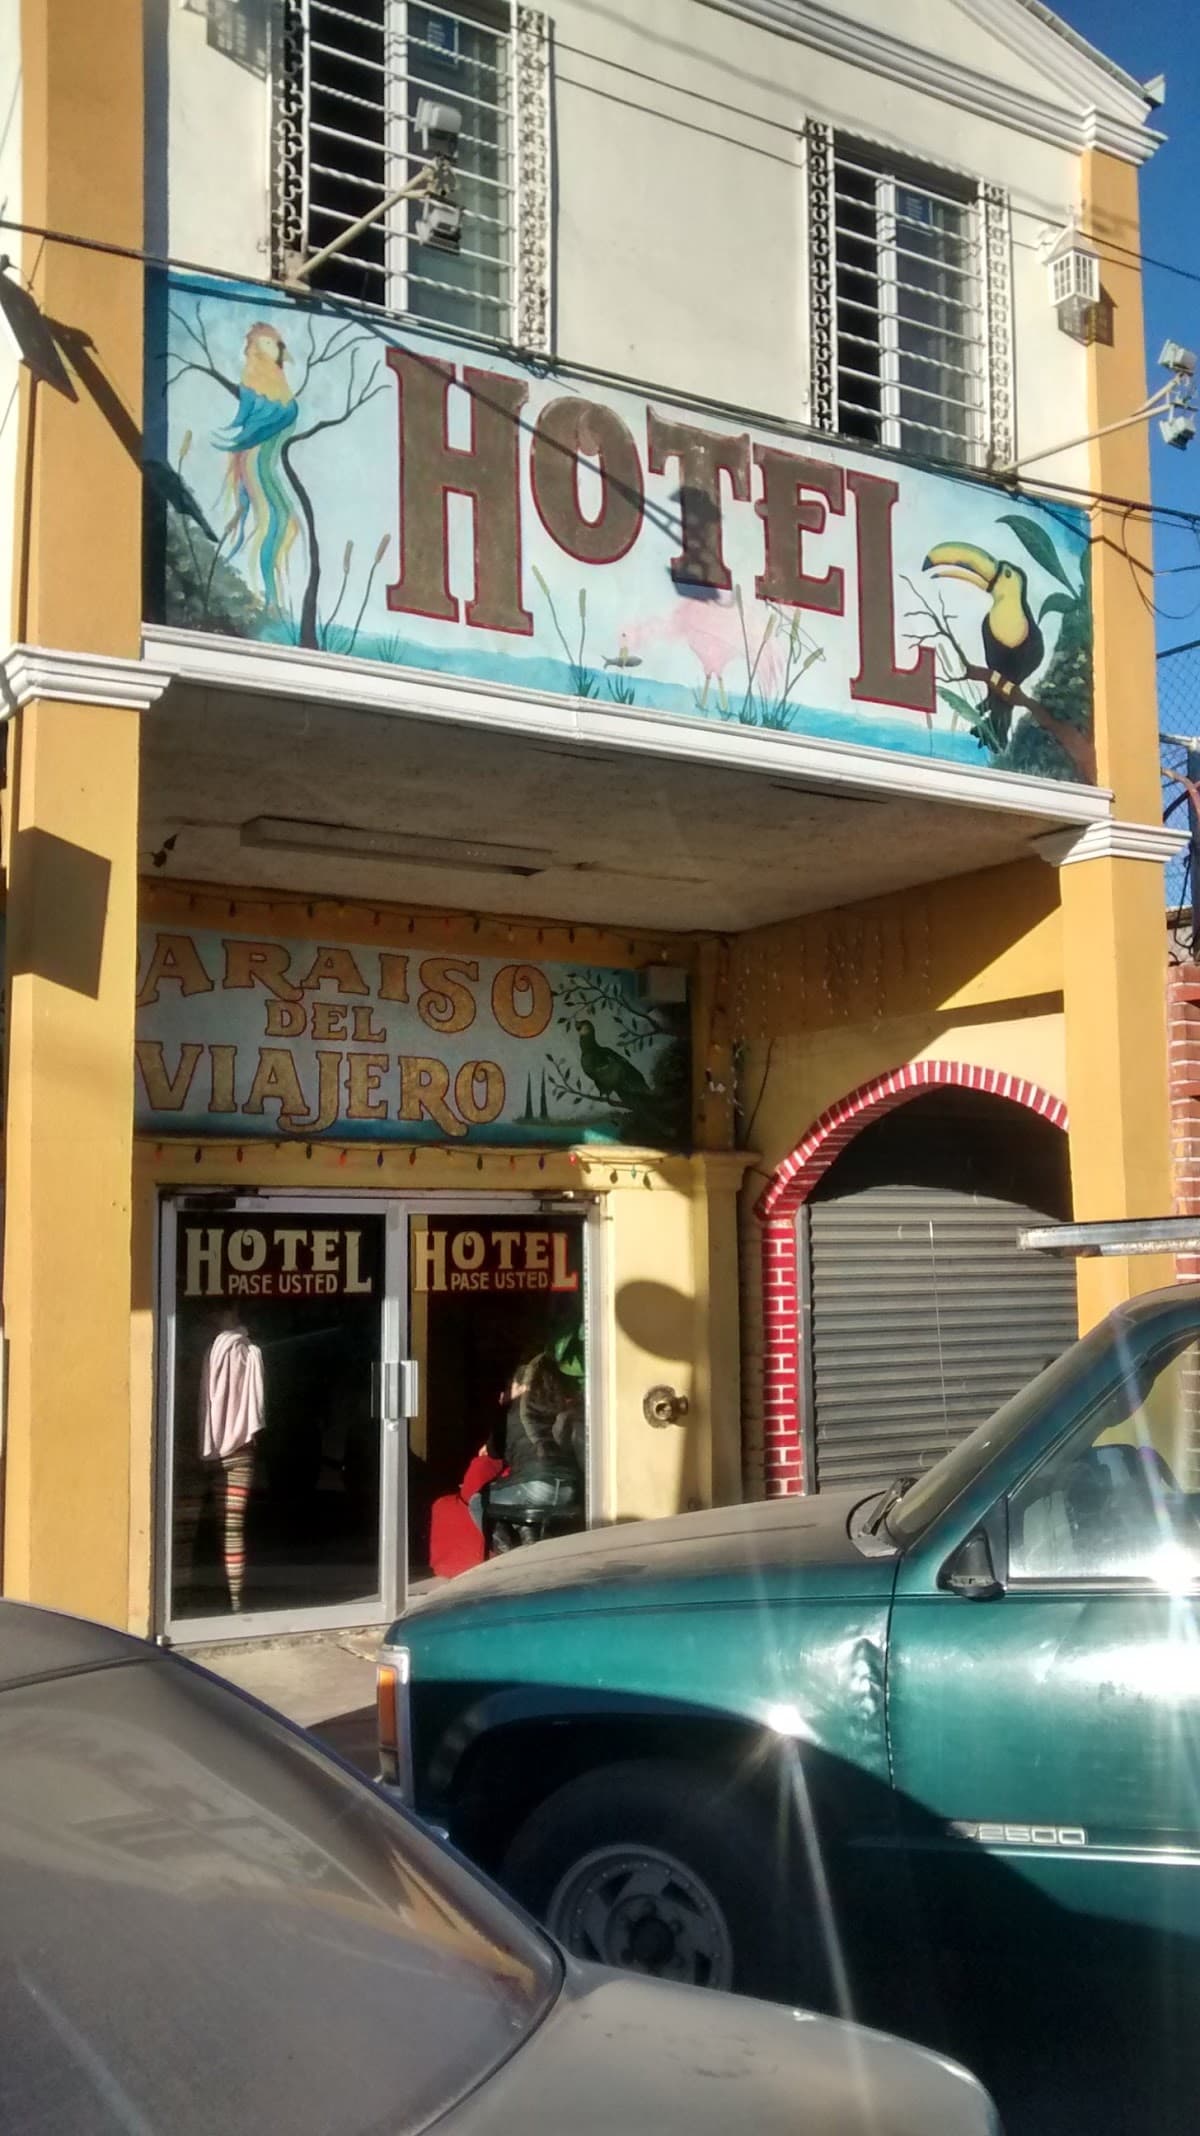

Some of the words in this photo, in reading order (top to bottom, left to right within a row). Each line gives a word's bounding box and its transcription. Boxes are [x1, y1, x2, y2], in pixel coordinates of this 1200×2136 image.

[386, 346, 937, 713] HOTEL
[136, 932, 555, 1039] ARAISO
[264, 999, 387, 1043] DEL
[135, 1041, 506, 1137] VIAJERO
[184, 1228, 372, 1296] HOTEL
[228, 1272, 273, 1294] PASE
[279, 1272, 338, 1294] USTED
[414, 1230, 578, 1292] HOTEL
[451, 1271, 489, 1290] PASE
[495, 1271, 549, 1289] USTED
